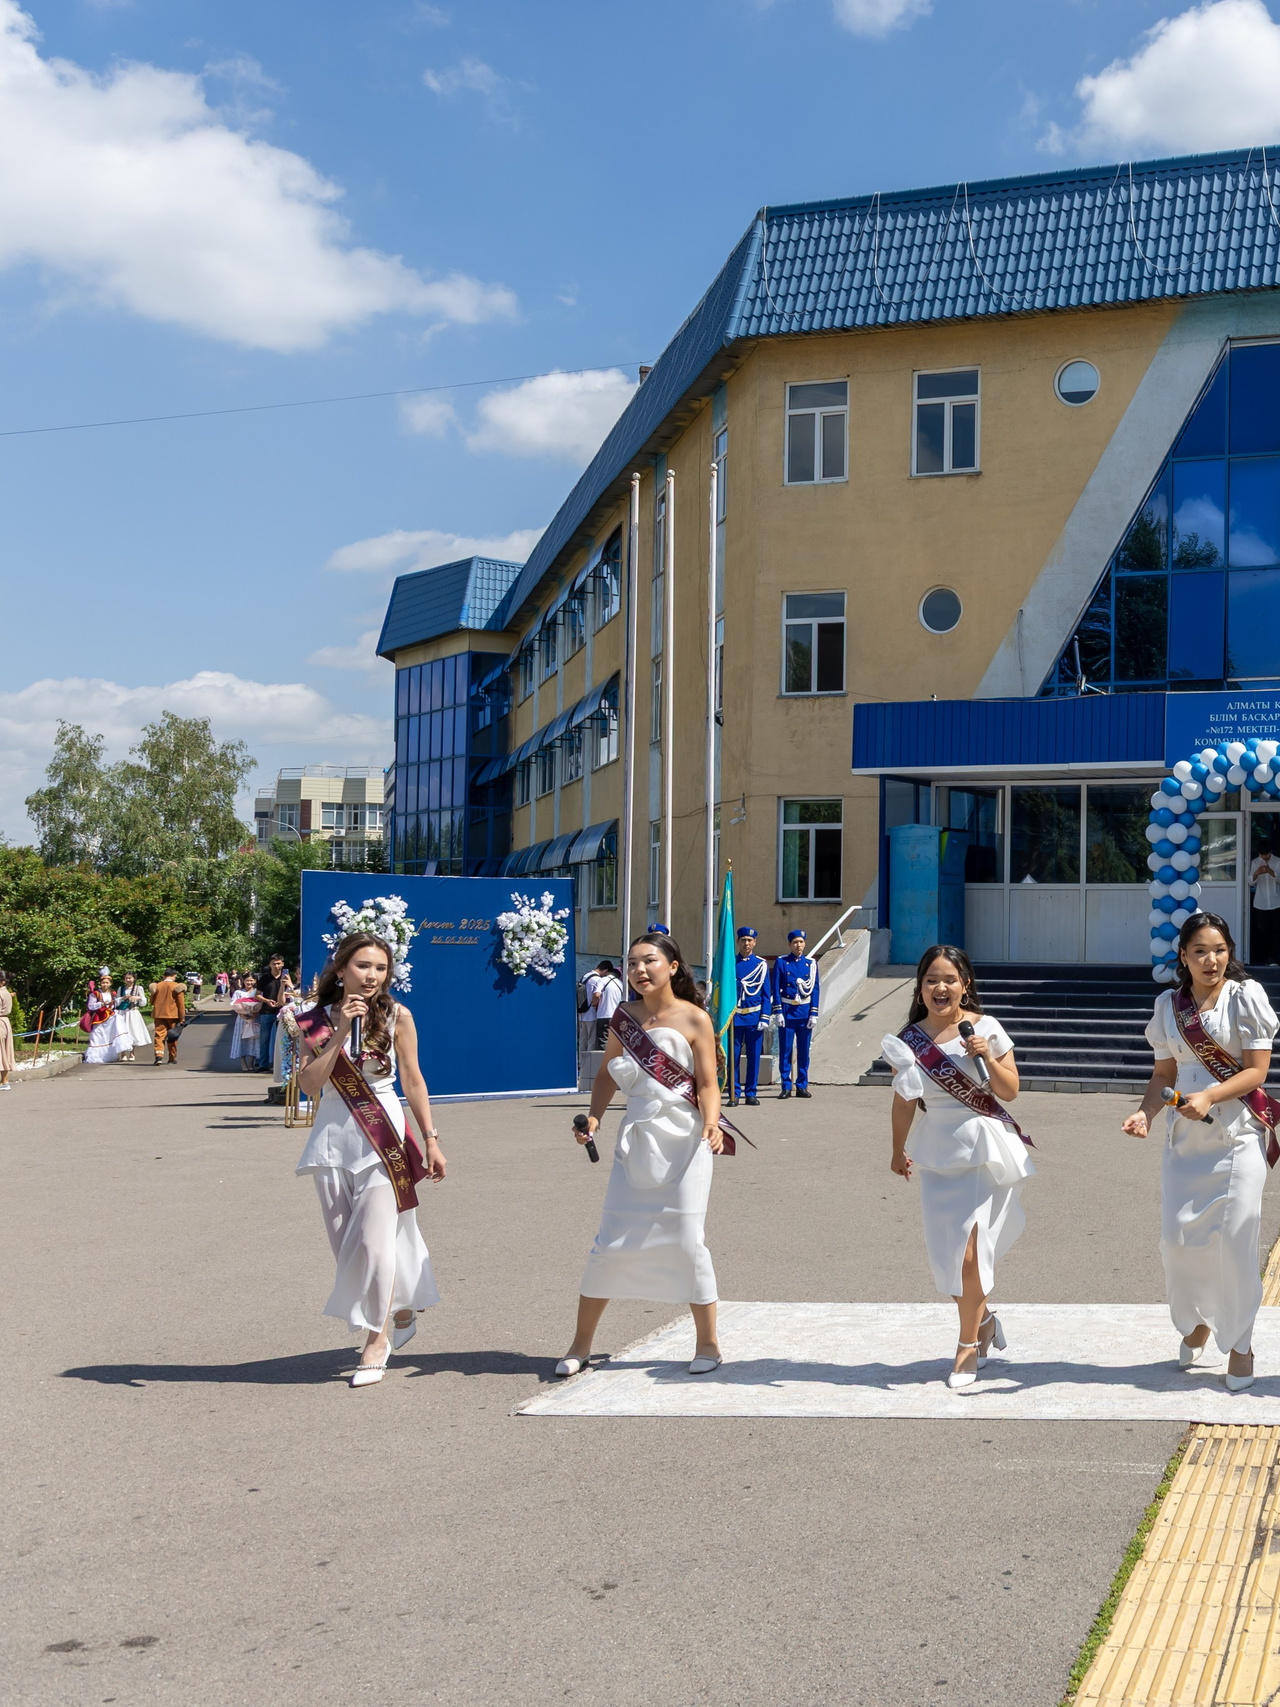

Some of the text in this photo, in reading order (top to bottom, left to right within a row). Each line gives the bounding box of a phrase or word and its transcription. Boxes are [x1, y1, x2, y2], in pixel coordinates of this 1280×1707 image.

[1227, 701, 1270, 710] АЛМАТЫ
[1209, 713, 1238, 722] БІЛІМ
[1205, 725, 1234, 735] «№172
[416, 918, 491, 934] prom 2025
[931, 1061, 990, 1111] Graduate
[338, 1073, 360, 1098] Jas
[384, 1146, 407, 1172] 2025
